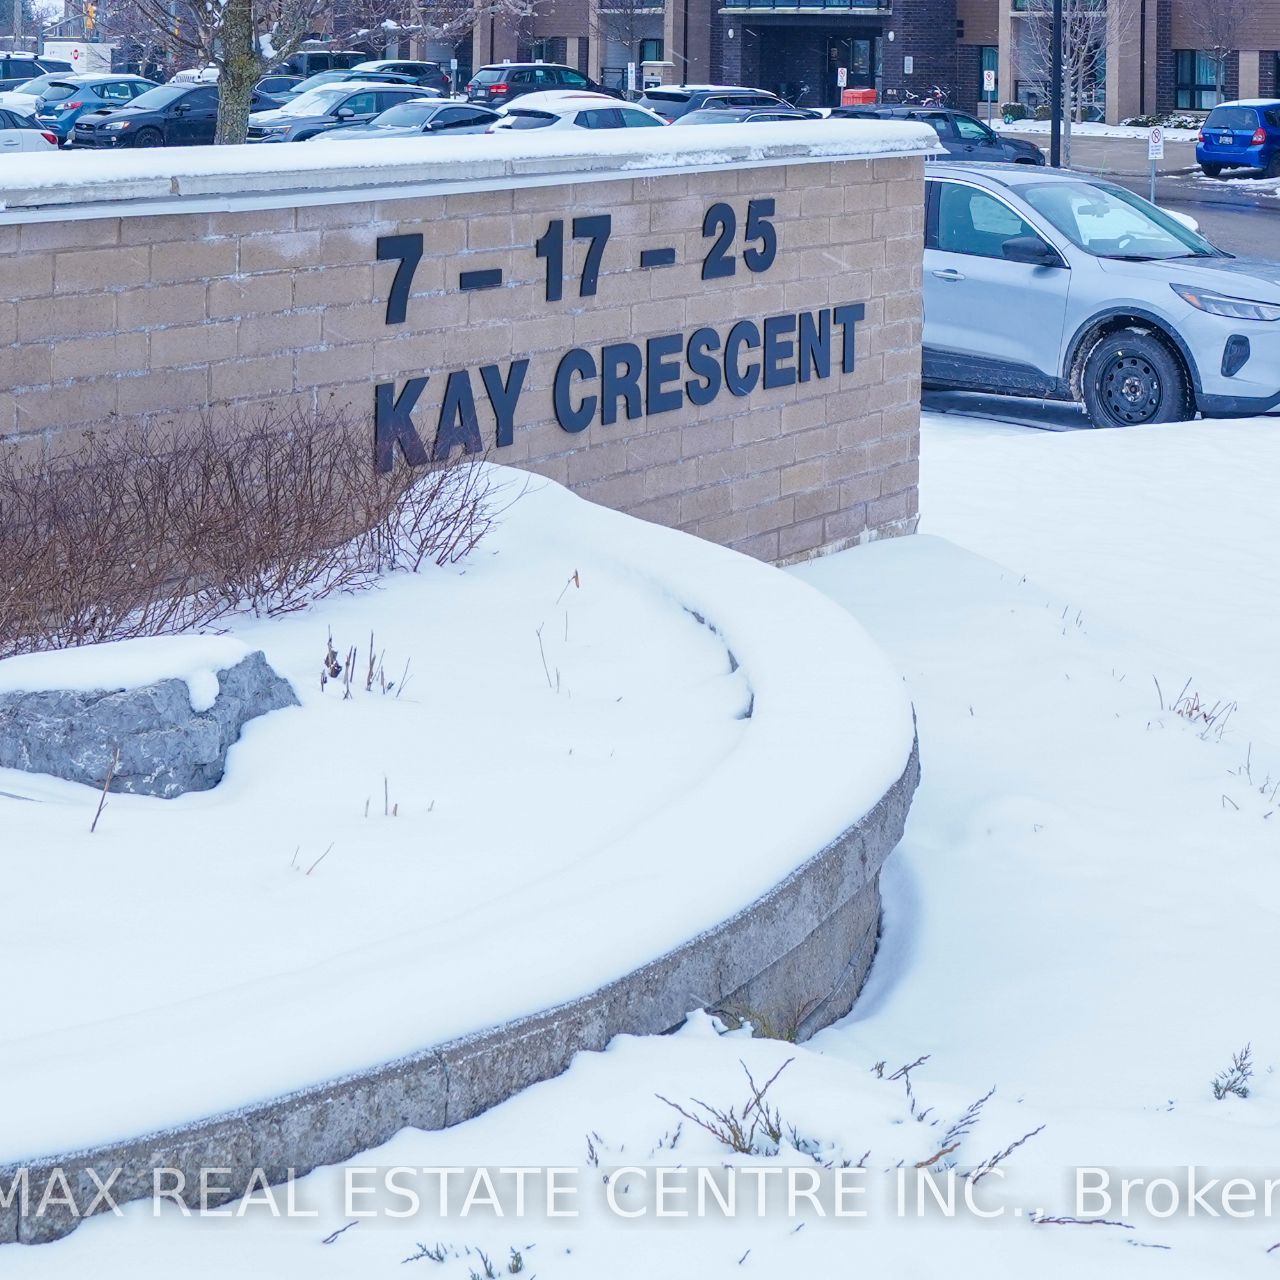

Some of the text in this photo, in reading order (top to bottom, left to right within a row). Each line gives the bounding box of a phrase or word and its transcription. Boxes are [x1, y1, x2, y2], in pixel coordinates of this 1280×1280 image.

[376, 232, 423, 325] 7
[535, 214, 612, 302] 17
[701, 198, 777, 281] 25
[374, 302, 866, 474] KAY CRESCENT
